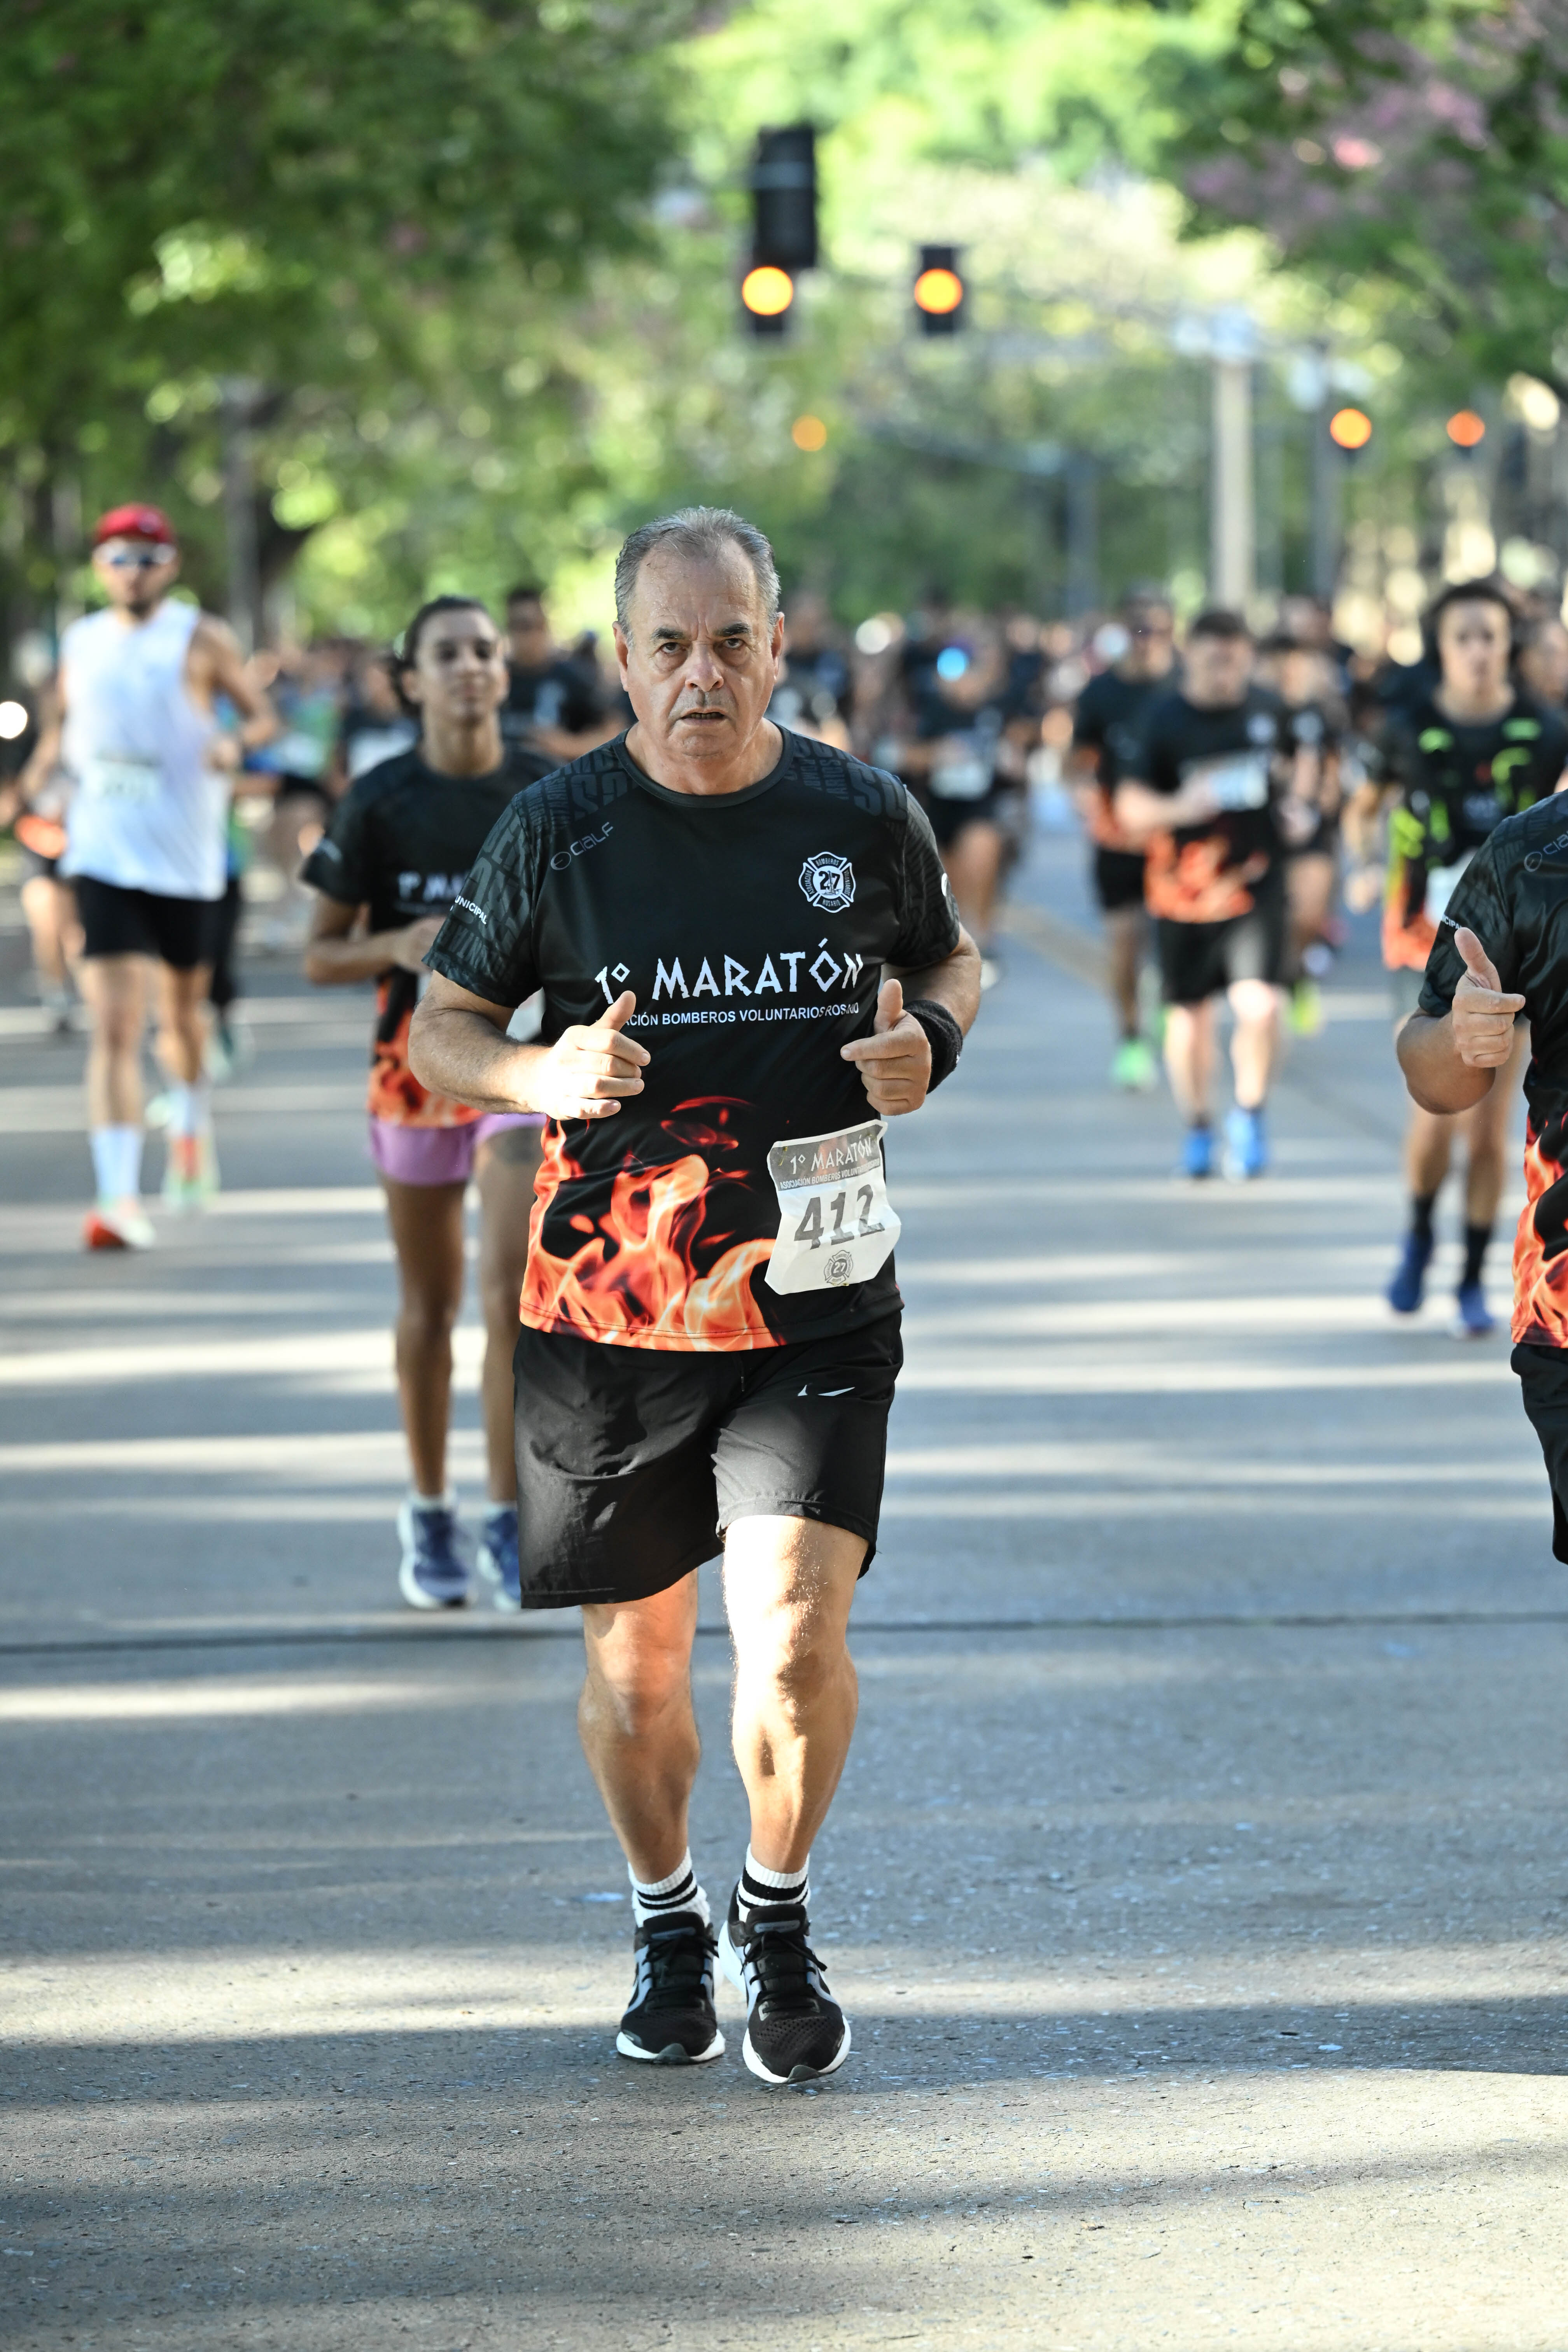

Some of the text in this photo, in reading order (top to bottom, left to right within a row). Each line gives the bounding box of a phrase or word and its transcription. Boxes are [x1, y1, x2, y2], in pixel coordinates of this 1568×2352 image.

[818, 871, 840, 890] 27
[652, 938, 864, 1001] MARATÓN
[662, 1010, 736, 1025] BOMBEROS
[810, 1134, 872, 1172] MARATÓN
[811, 1171, 841, 1184] BOMBEROS
[793, 1184, 885, 1250] 412
[833, 1262, 846, 1274] 27
